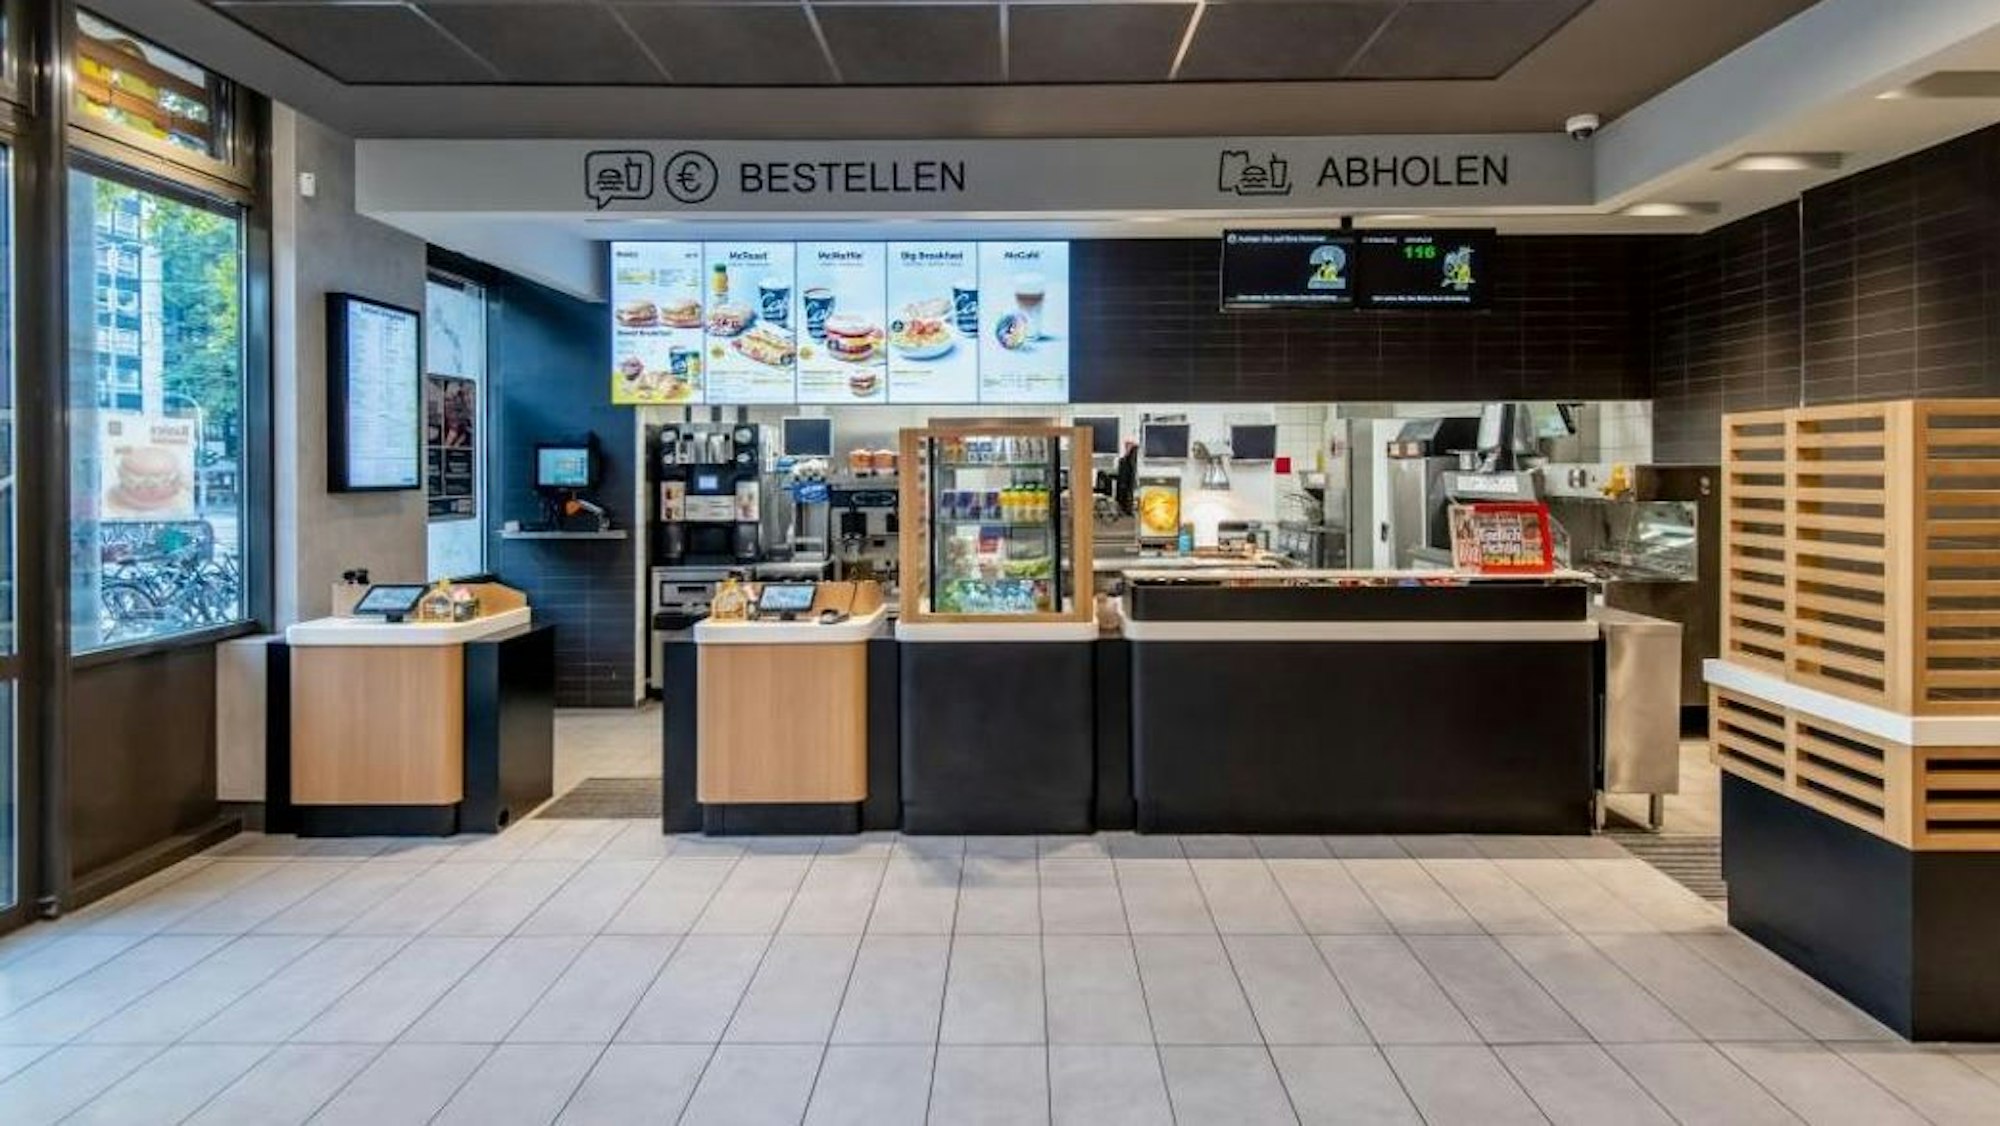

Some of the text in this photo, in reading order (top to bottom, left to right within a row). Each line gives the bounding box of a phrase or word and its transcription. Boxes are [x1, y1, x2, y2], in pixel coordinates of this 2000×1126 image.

[740, 161, 966, 193] BESTELLEN
[1316, 155, 1509, 187] ABHOLEN
[920, 251, 963, 260] Breakfast
[1404, 245, 1436, 259] 116
